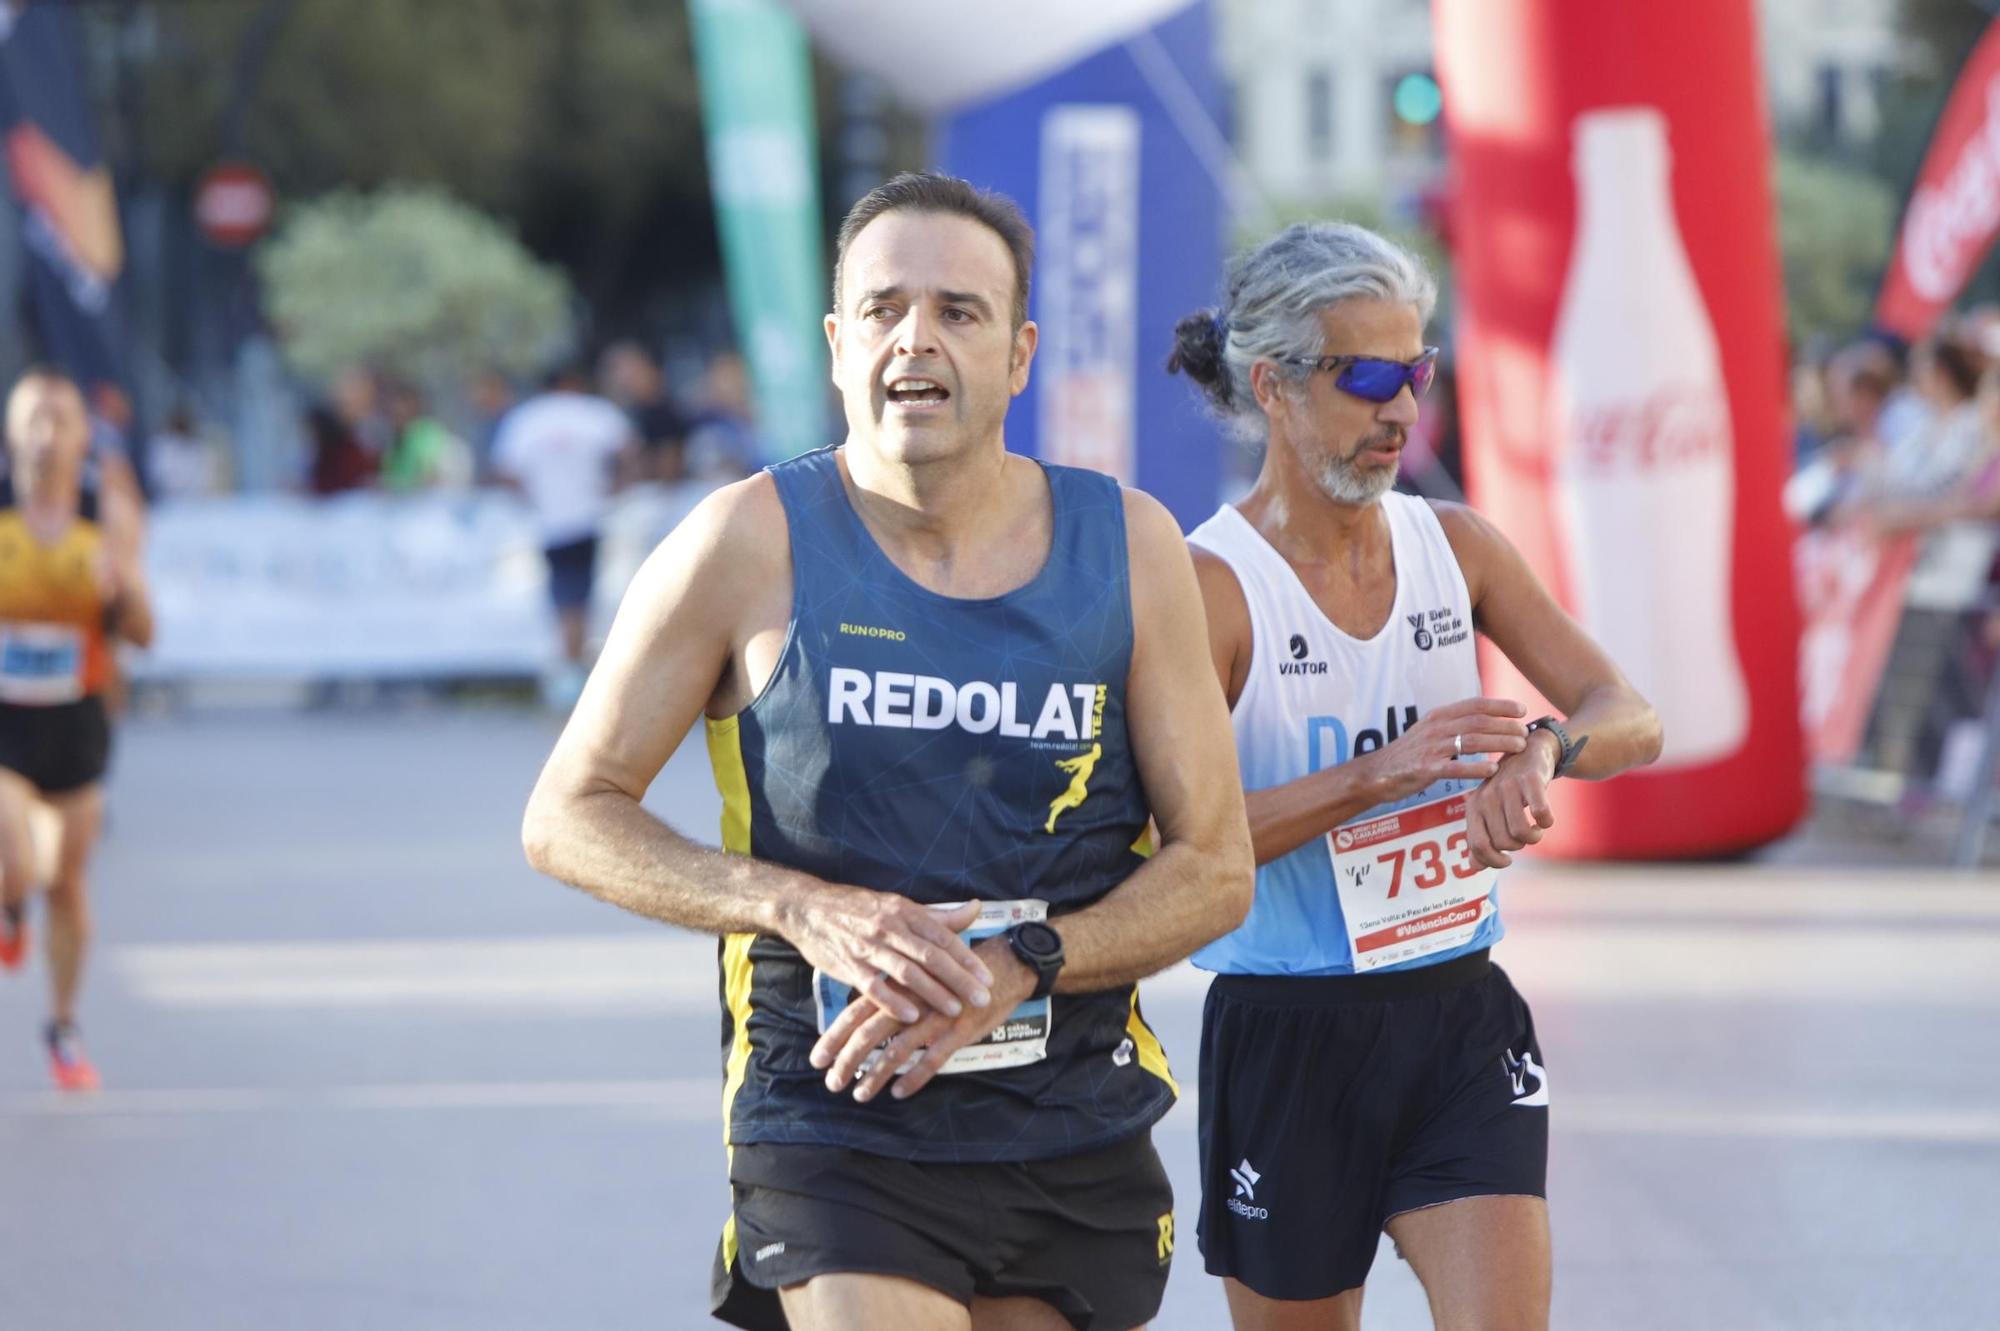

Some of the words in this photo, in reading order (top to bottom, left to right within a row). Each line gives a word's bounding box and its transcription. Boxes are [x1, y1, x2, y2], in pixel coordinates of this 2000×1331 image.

[1279, 661, 1328, 675] VIATOR
[828, 667, 1096, 740] REDOLAT
[1092, 684, 1107, 737] TEAM
[1377, 830, 1479, 899] 733
[1227, 1197, 1269, 1221] elitepro
